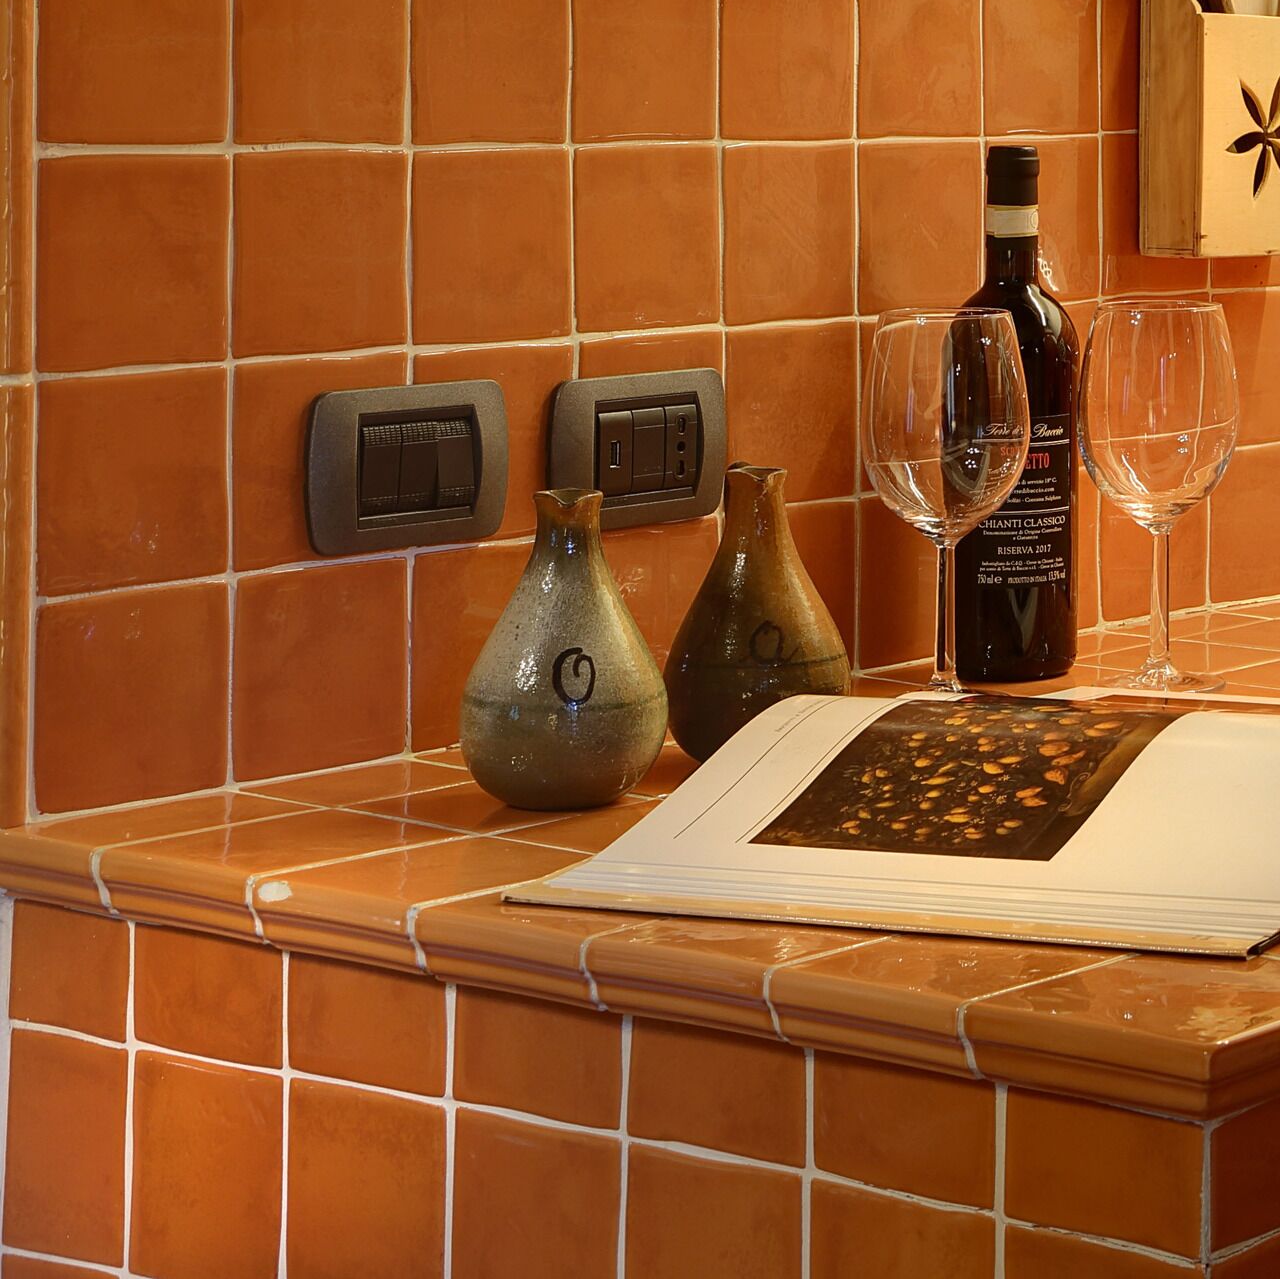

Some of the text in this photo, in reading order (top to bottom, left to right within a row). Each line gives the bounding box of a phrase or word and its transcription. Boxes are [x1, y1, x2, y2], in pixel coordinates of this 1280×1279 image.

[978, 515, 1066, 529] CHIANTI CLASSICO
[997, 543, 1052, 556] RISERVA 2017
